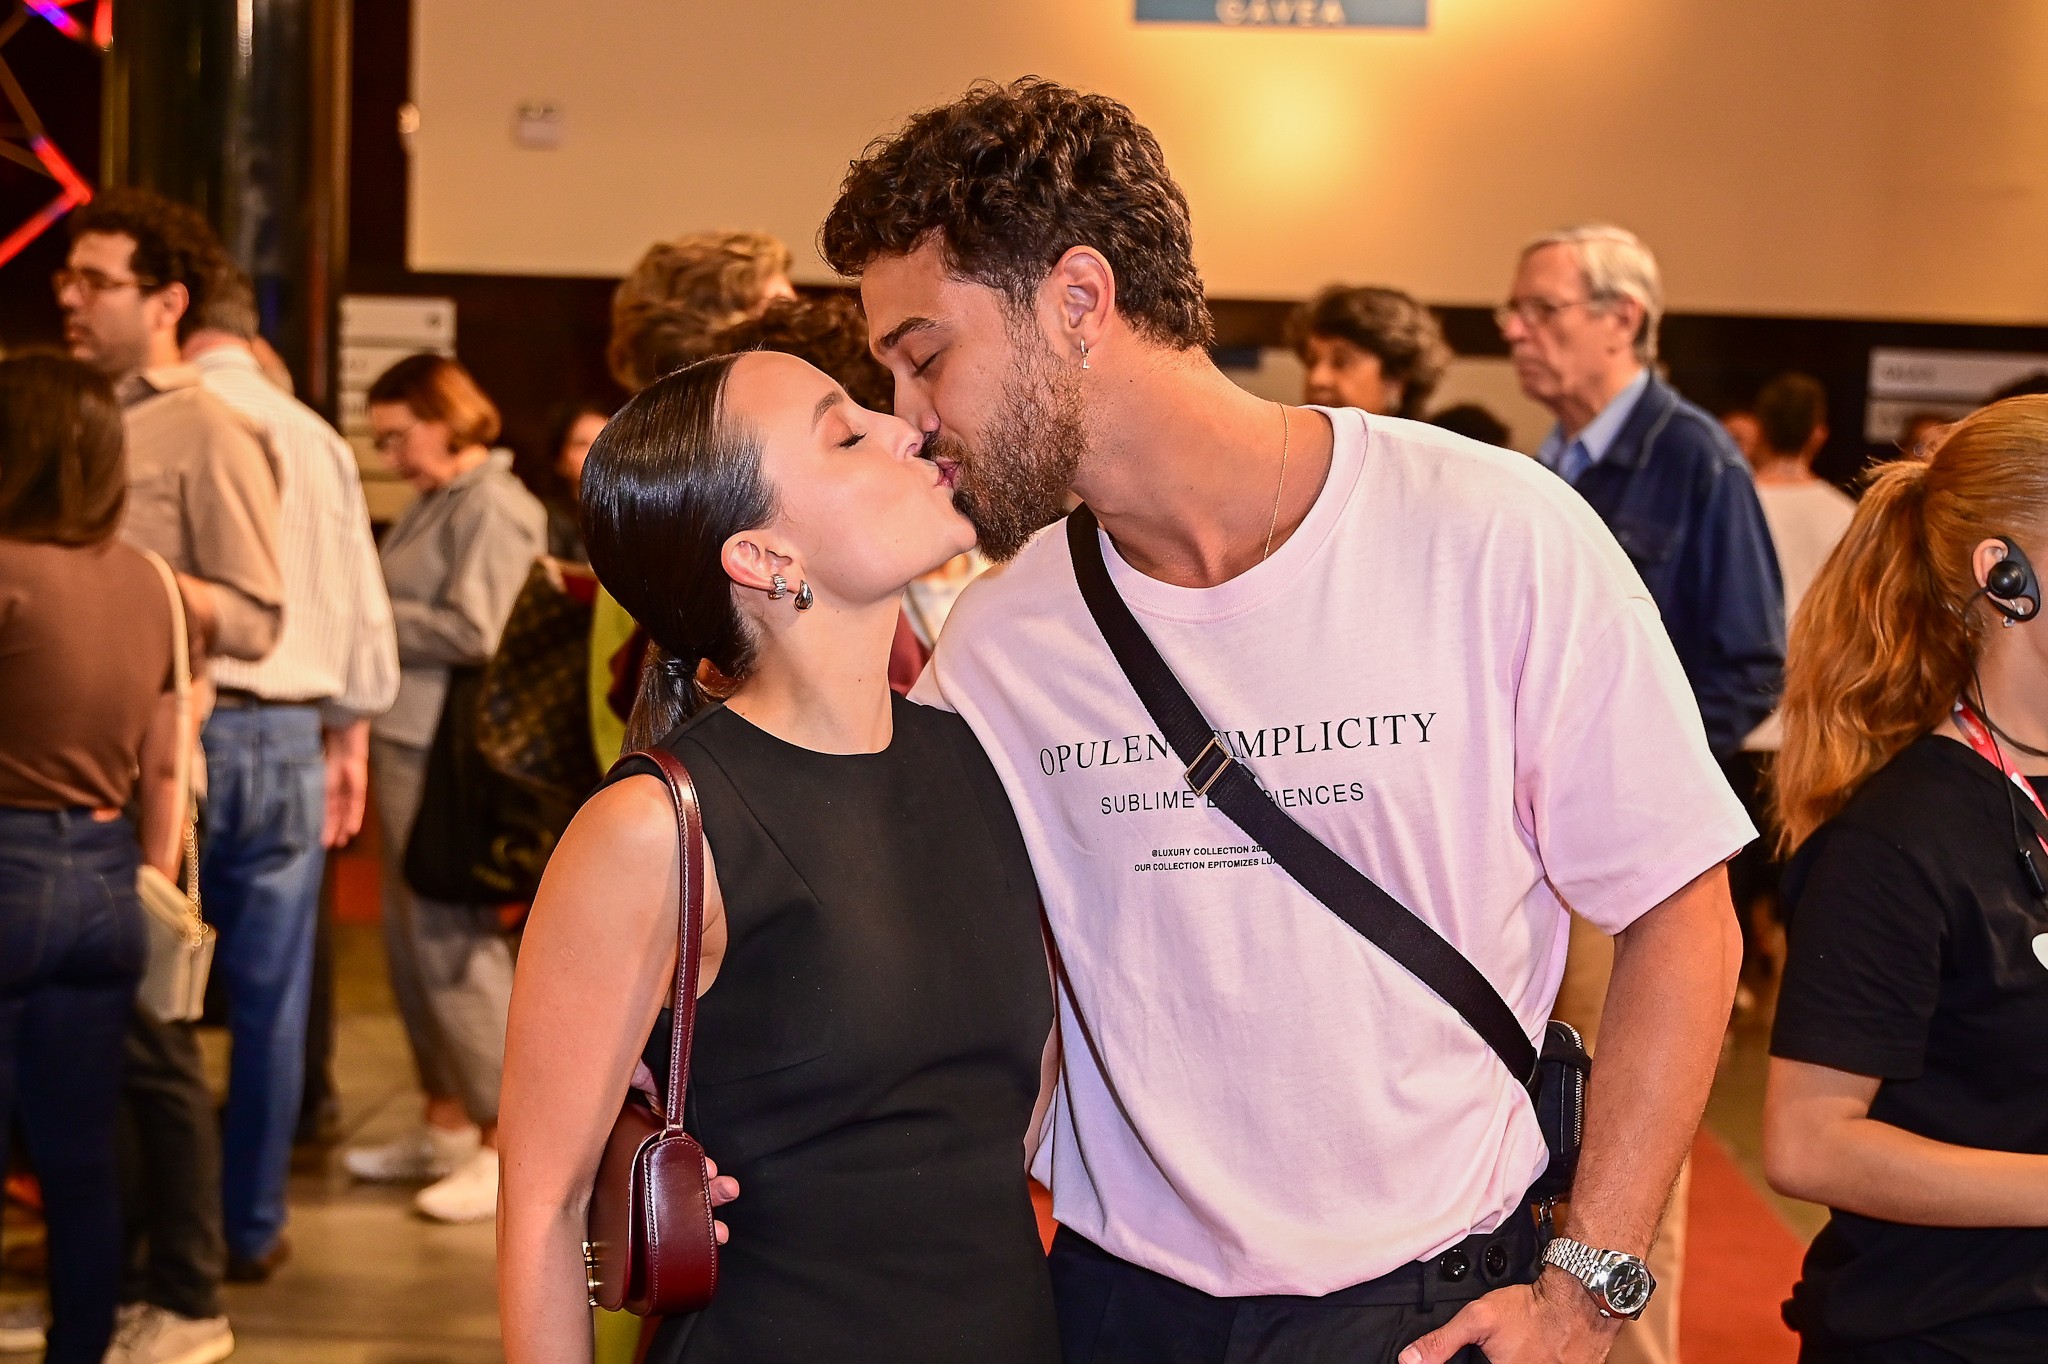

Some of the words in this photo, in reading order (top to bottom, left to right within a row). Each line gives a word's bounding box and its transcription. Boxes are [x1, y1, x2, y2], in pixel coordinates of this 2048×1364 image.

[1039, 733, 1171, 776] OPULEN
[1100, 790, 1196, 815] SUBLIME
[1193, 845, 1249, 856] COLLECTION
[1134, 863, 1152, 872] OUR
[1153, 861, 1205, 871] COLLECTION
[1207, 858, 1259, 869] EPITOMIZES
